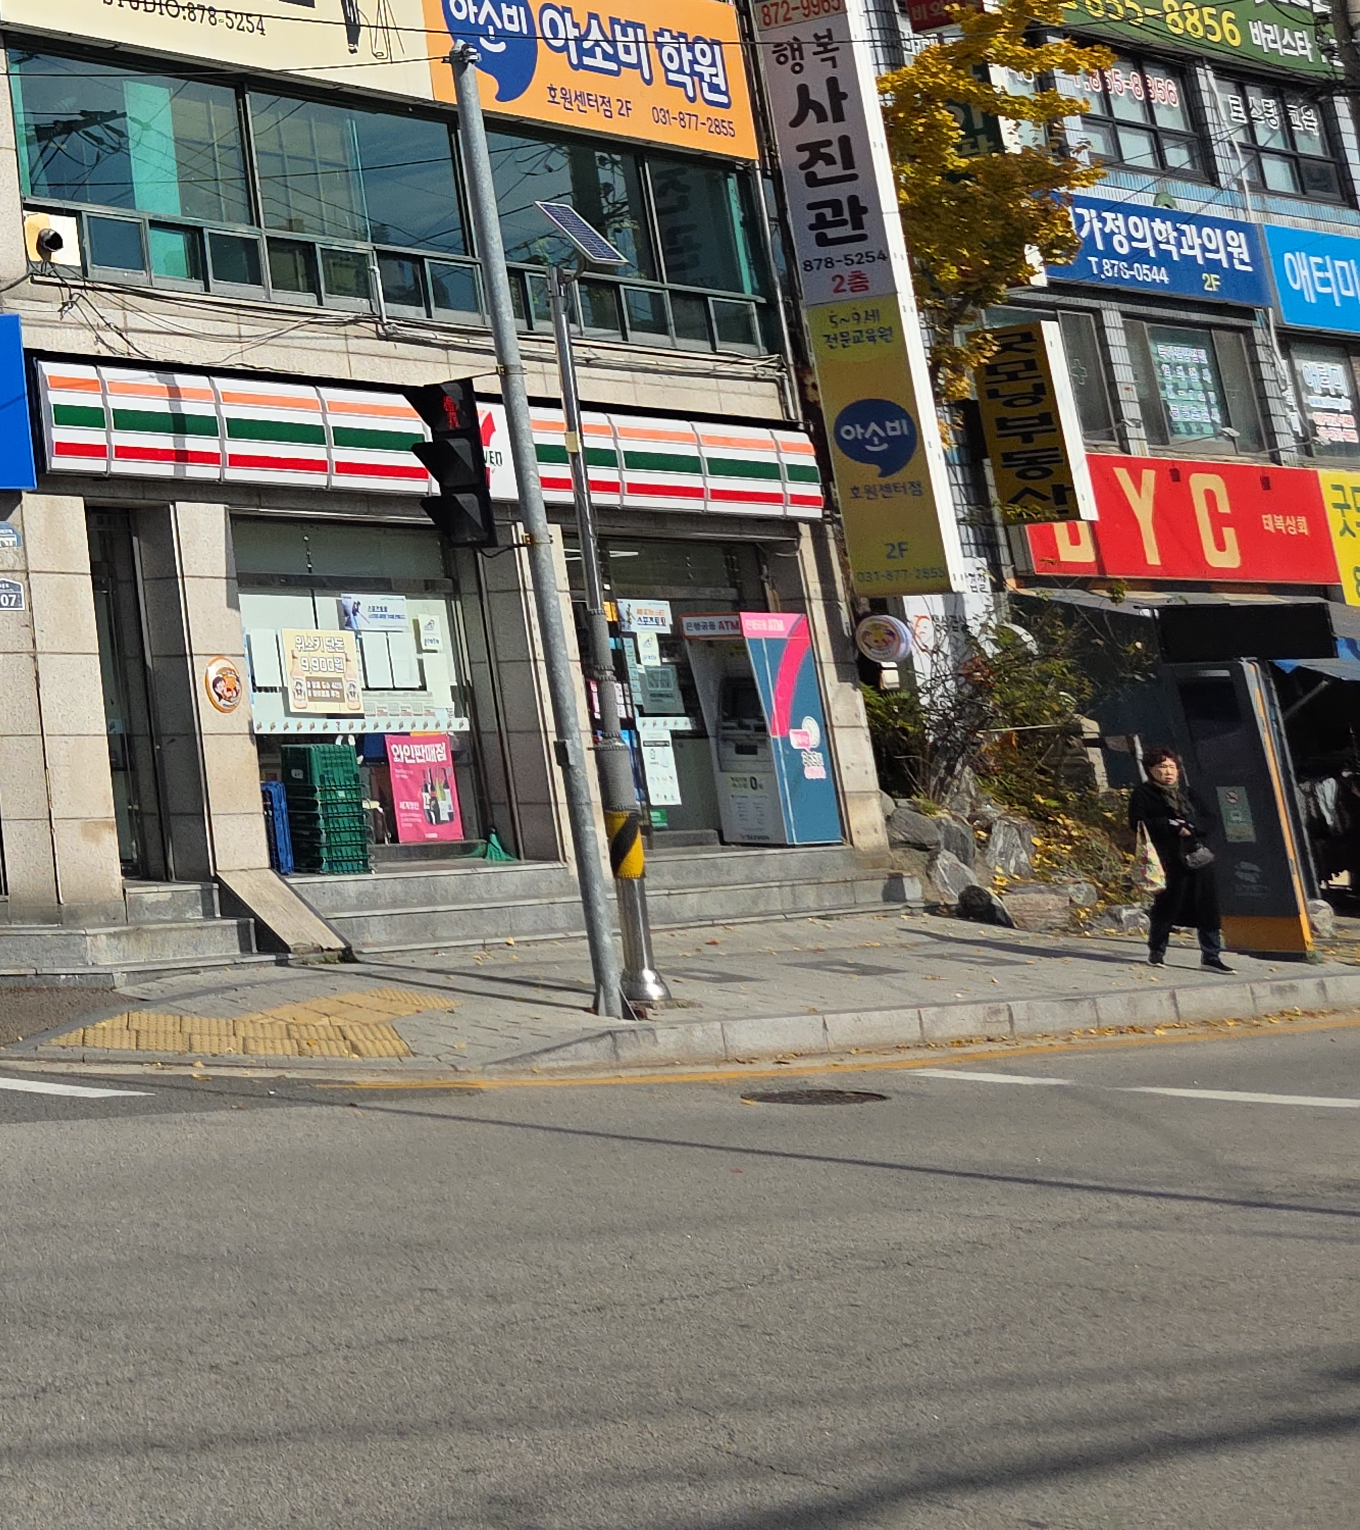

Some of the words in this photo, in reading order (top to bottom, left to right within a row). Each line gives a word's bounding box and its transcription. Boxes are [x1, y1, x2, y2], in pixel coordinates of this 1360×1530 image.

[539, 3, 653, 86] 아소비
[654, 28, 733, 108] 학원
[771, 28, 841, 76] 행복
[1247, 20, 1315, 64] 바리스타
[546, 83, 614, 118] 호원센터점
[617, 98, 633, 118] 2F
[651, 106, 736, 138] 031-877-2855
[789, 76, 870, 248] 사진관
[1077, 207, 1254, 272] 가정의학과의원
[802, 249, 888, 272] 878-5254
[831, 270, 870, 294] 2층
[1201, 274, 1221, 292] 2F
[840, 420, 910, 453] 아소비
[885, 543, 909, 562] 2F
[717, 617, 740, 632] ATM
[294, 634, 325, 654] 위스키
[390, 742, 448, 765] 와인판매점
